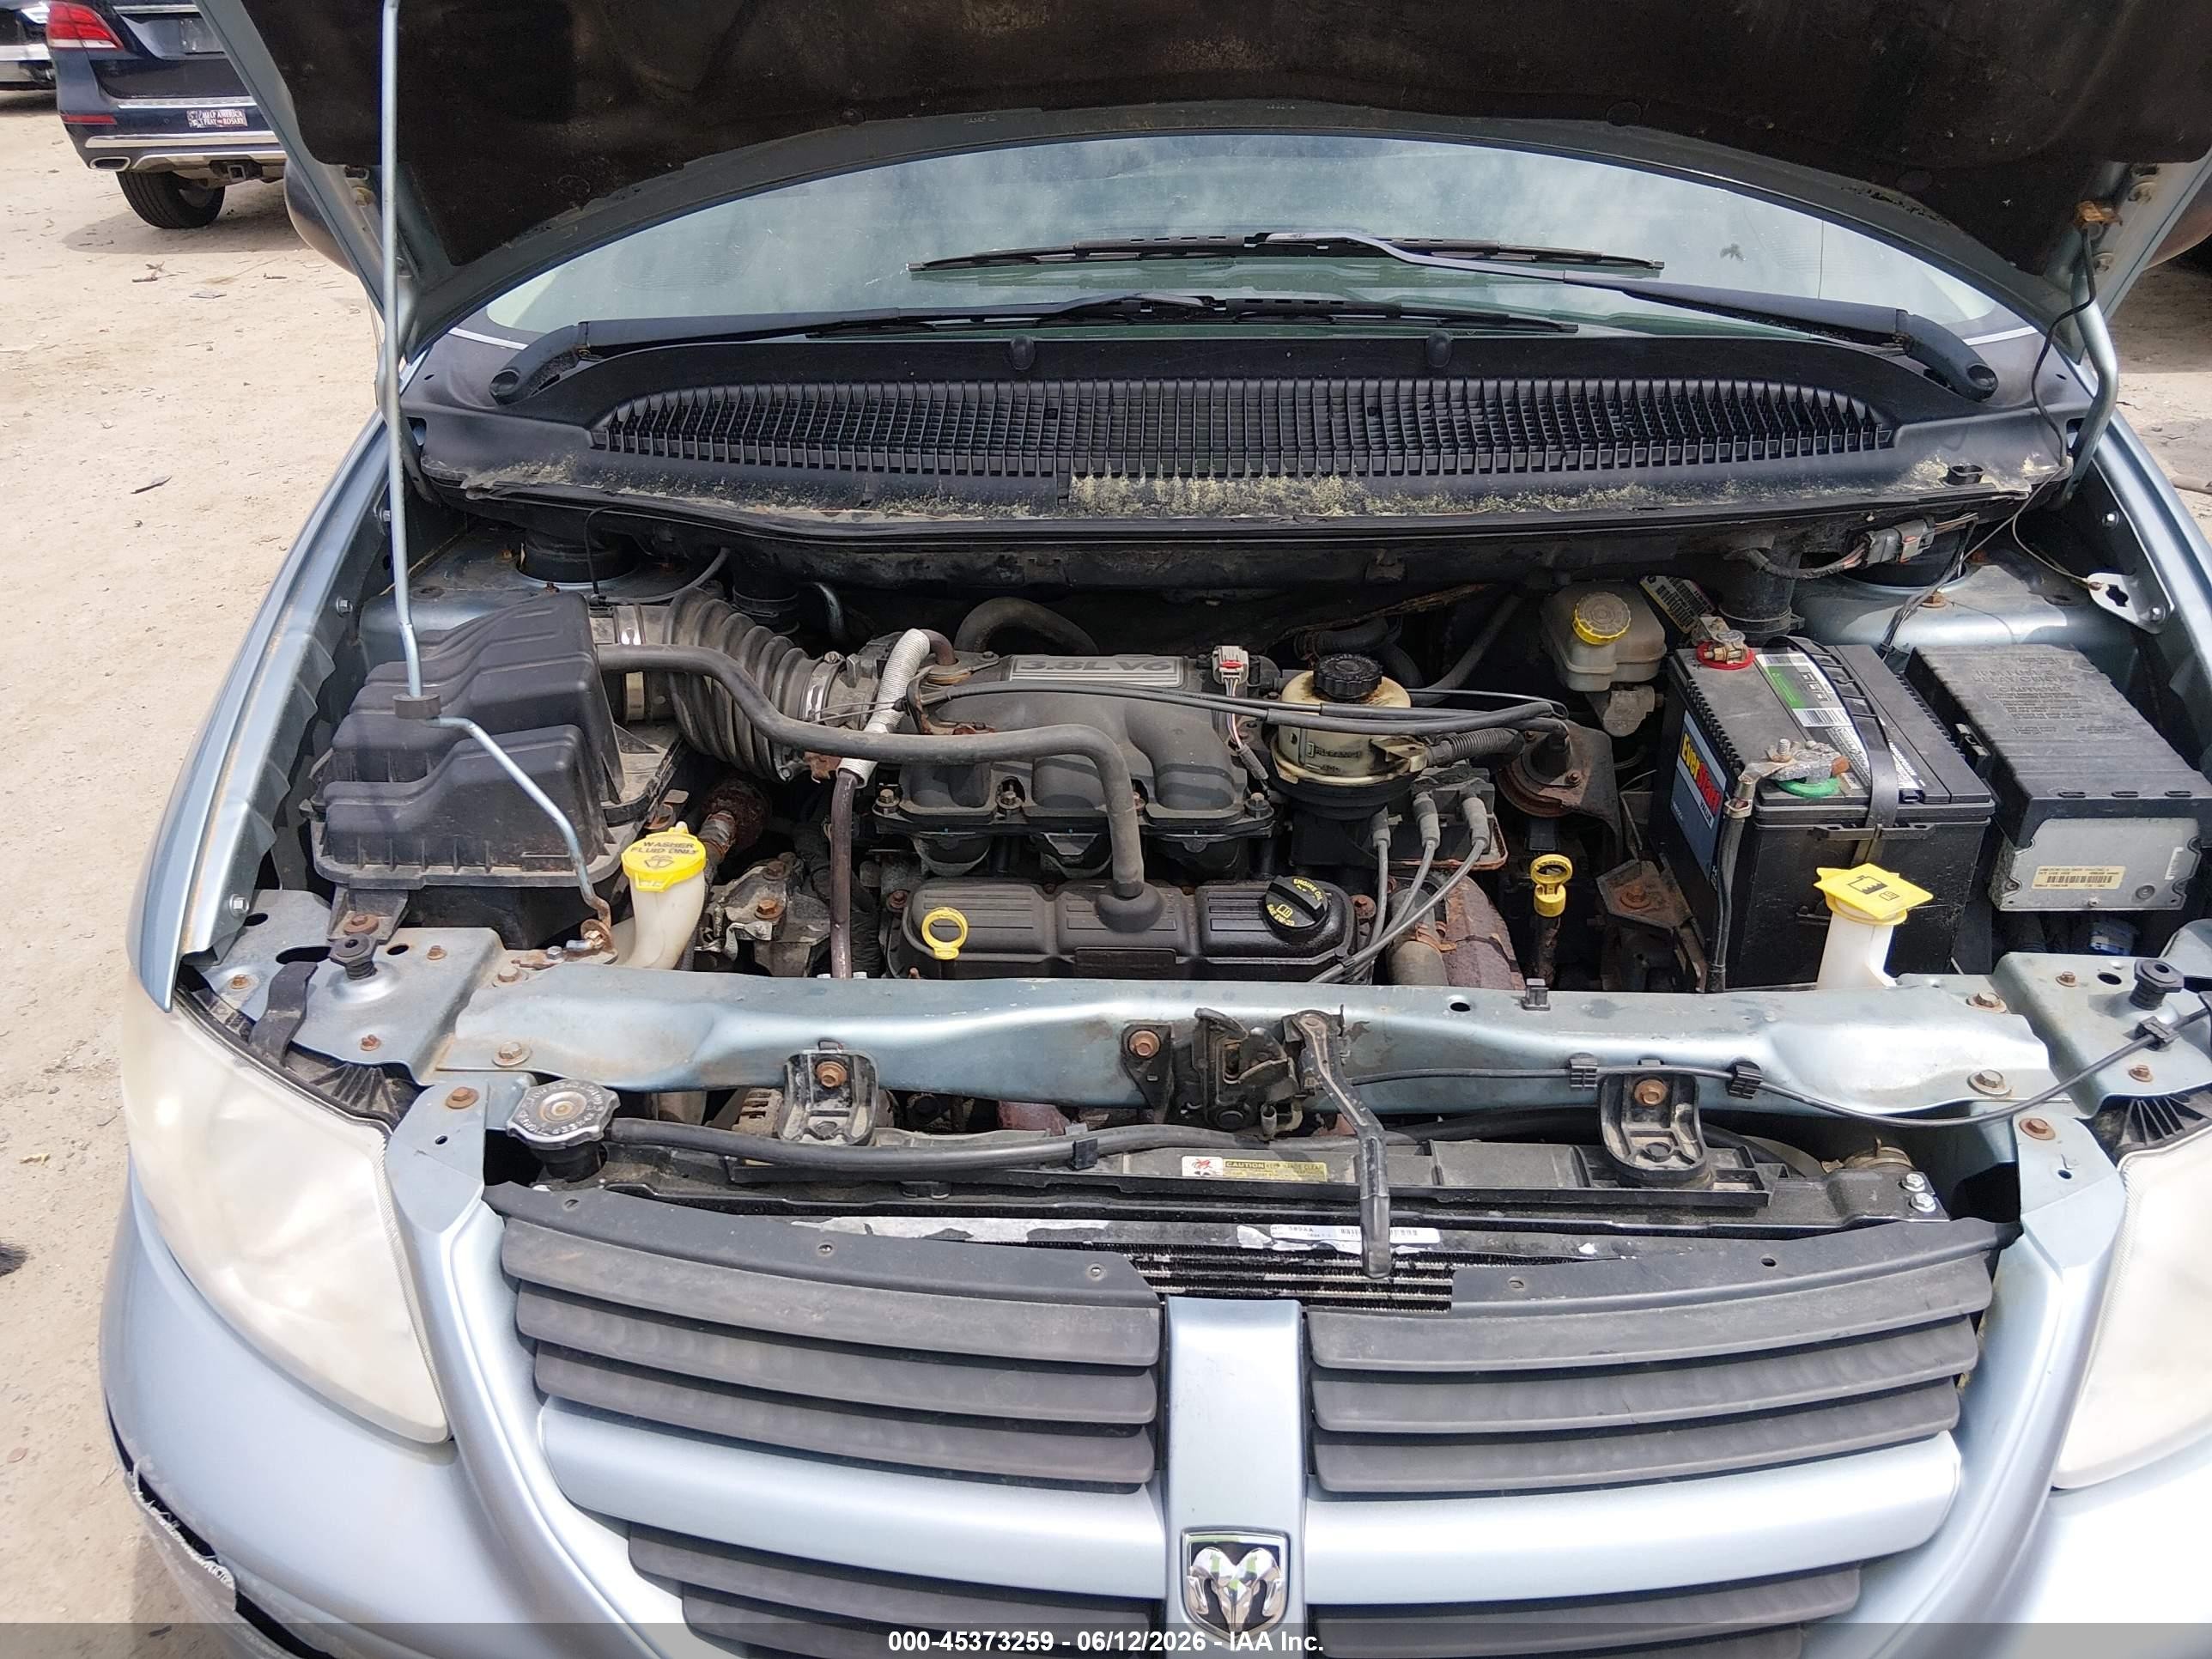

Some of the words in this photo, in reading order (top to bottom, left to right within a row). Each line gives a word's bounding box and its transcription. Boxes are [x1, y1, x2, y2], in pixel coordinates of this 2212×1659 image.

[1021, 659, 1110, 671] 3.8L
[1116, 660, 1172, 672] V6
[1293, 878, 1318, 892] ENGINE
[1315, 890, 1323, 901] OIL
[1267, 904, 1277, 916] SAE
